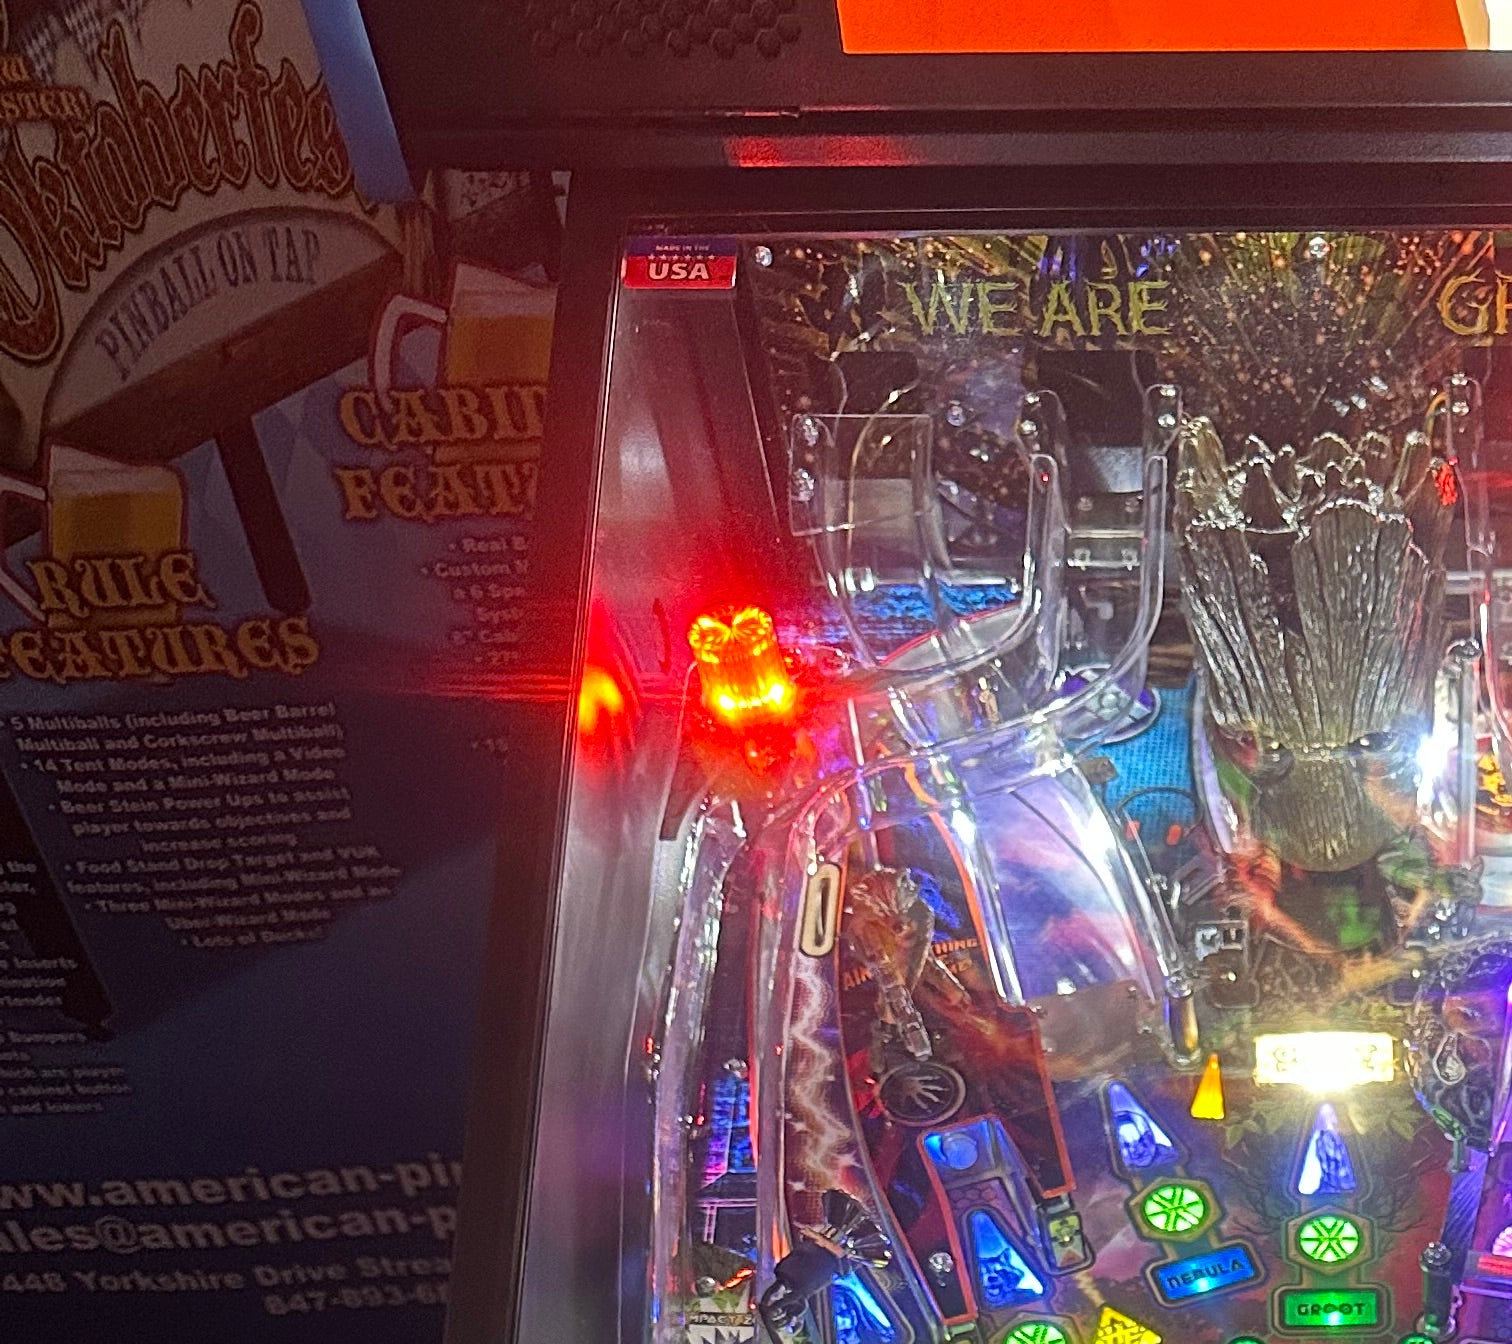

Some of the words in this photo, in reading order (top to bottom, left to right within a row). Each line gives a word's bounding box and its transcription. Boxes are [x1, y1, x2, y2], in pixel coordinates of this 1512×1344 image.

[648, 261, 710, 282] USA
[95, 250, 218, 382] PINBALL
[216, 230, 258, 288] ON
[264, 226, 321, 285] TAP
[900, 280, 1022, 337] WE
[1038, 279, 1171, 337] ARE
[27, 553, 216, 618] RULE
[0, 614, 320, 685] EATURES
[72, 1266, 248, 1293] Yorkshire
[254, 1261, 348, 1288] Drive
[1165, 1257, 1245, 1289] NEBULA
